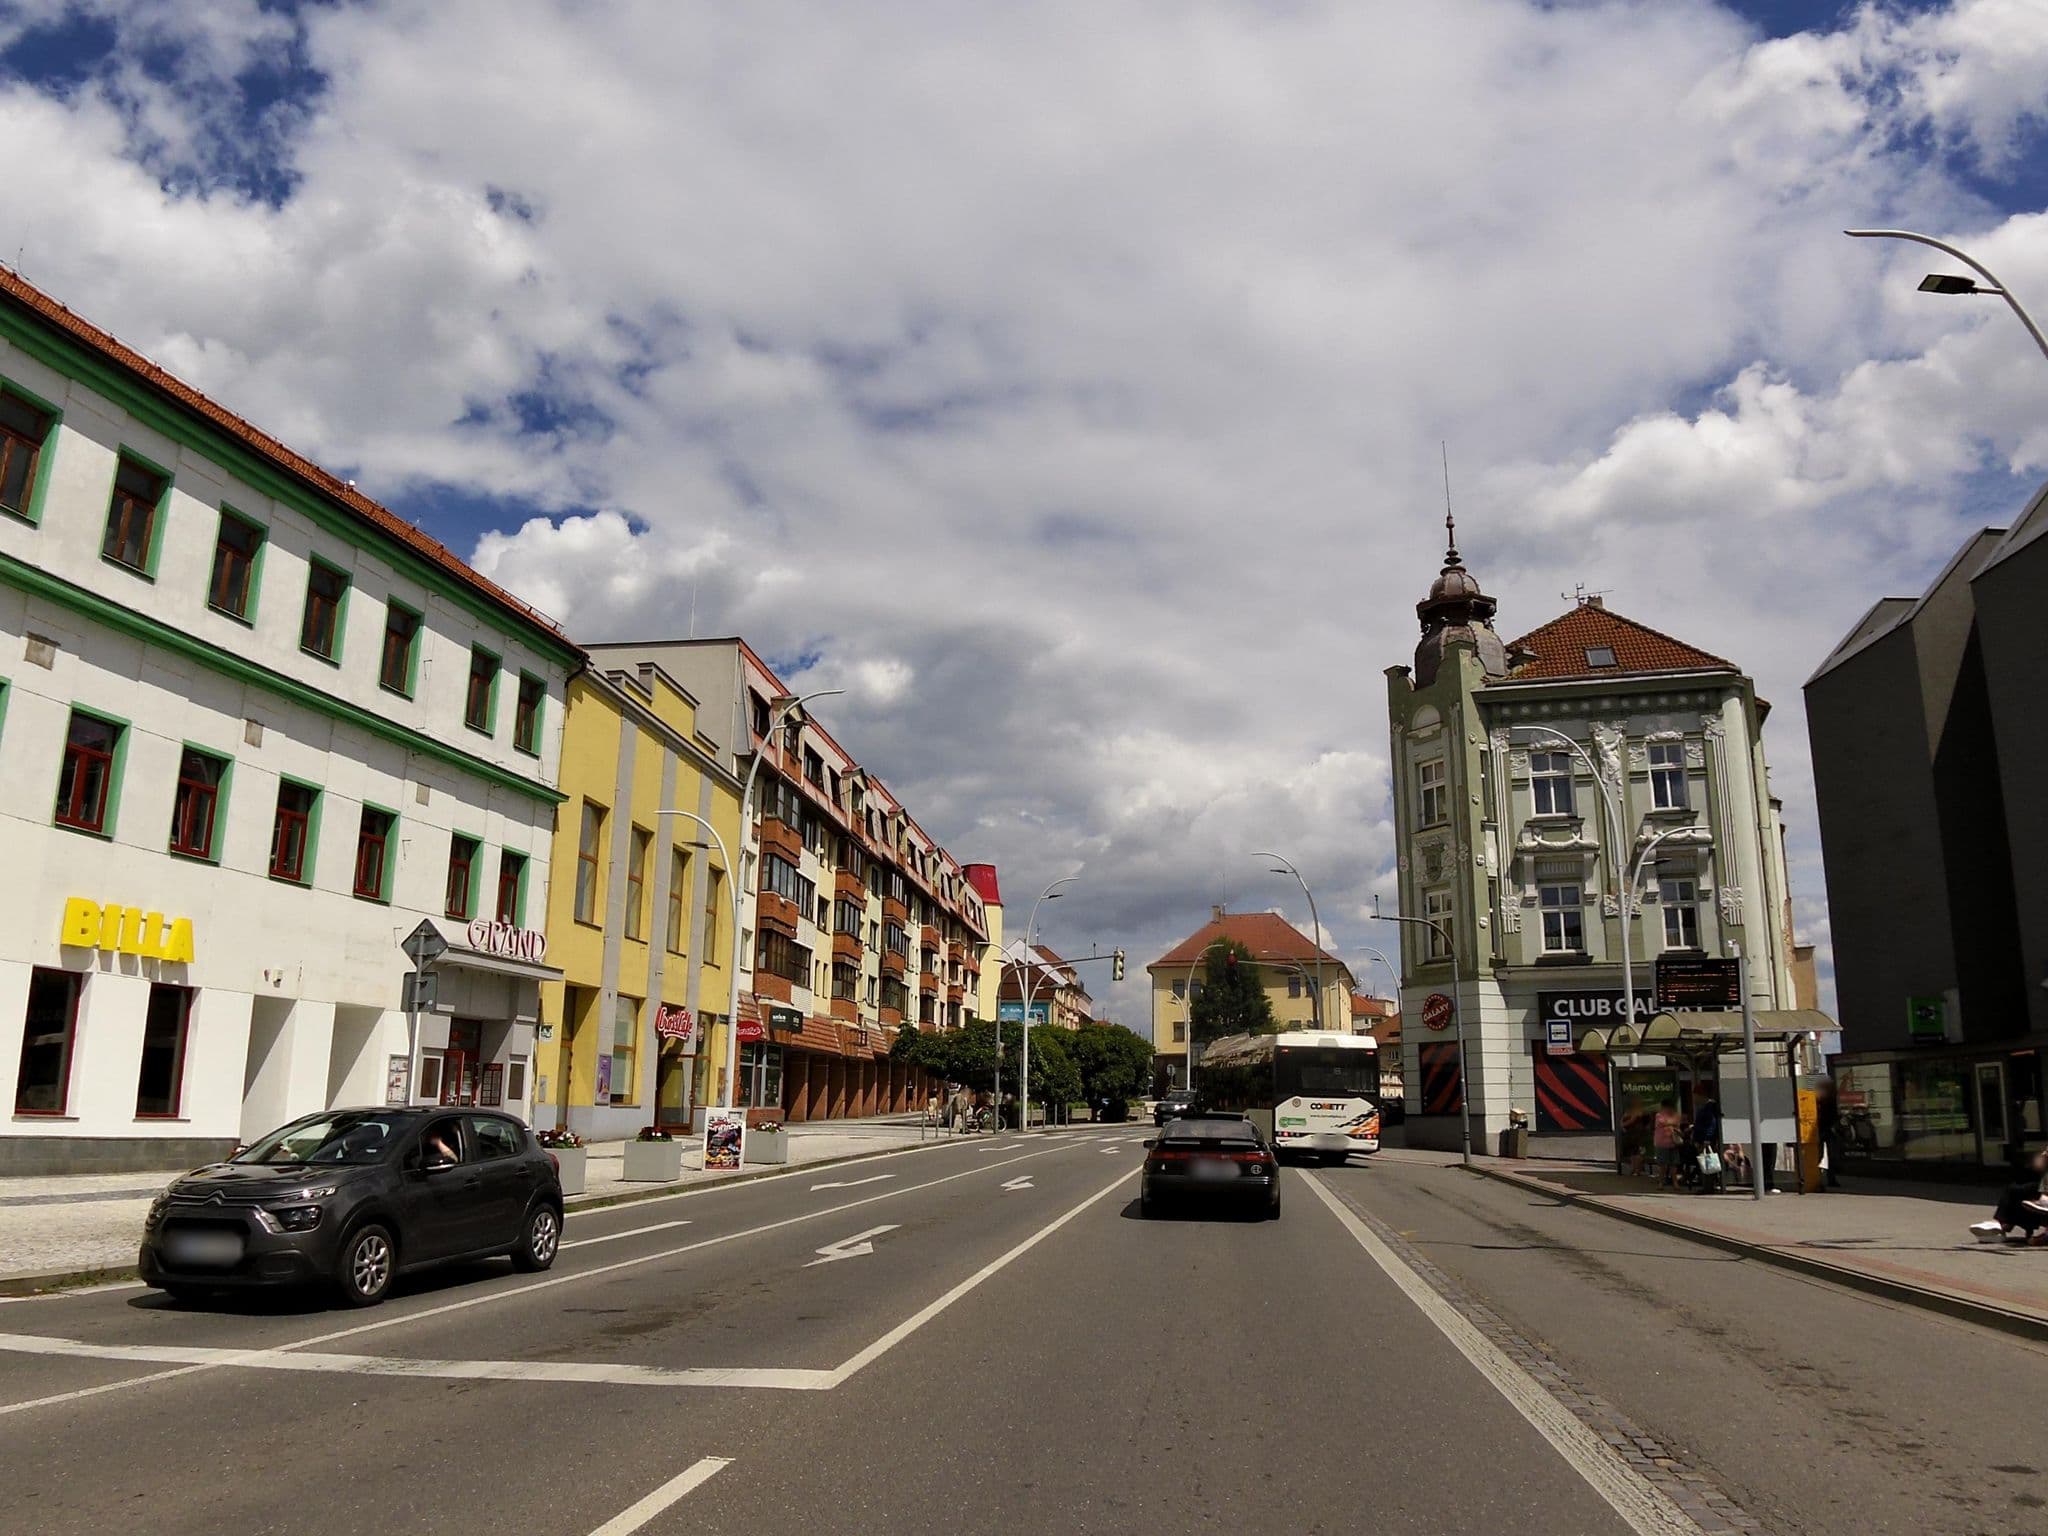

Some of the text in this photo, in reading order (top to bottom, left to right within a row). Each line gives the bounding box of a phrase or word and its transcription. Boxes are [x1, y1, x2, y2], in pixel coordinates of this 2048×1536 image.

[467, 918, 547, 959] GRAND
[1423, 1002, 1449, 1021] GALAXY
[1553, 998, 1703, 1017] CLUB GAL
